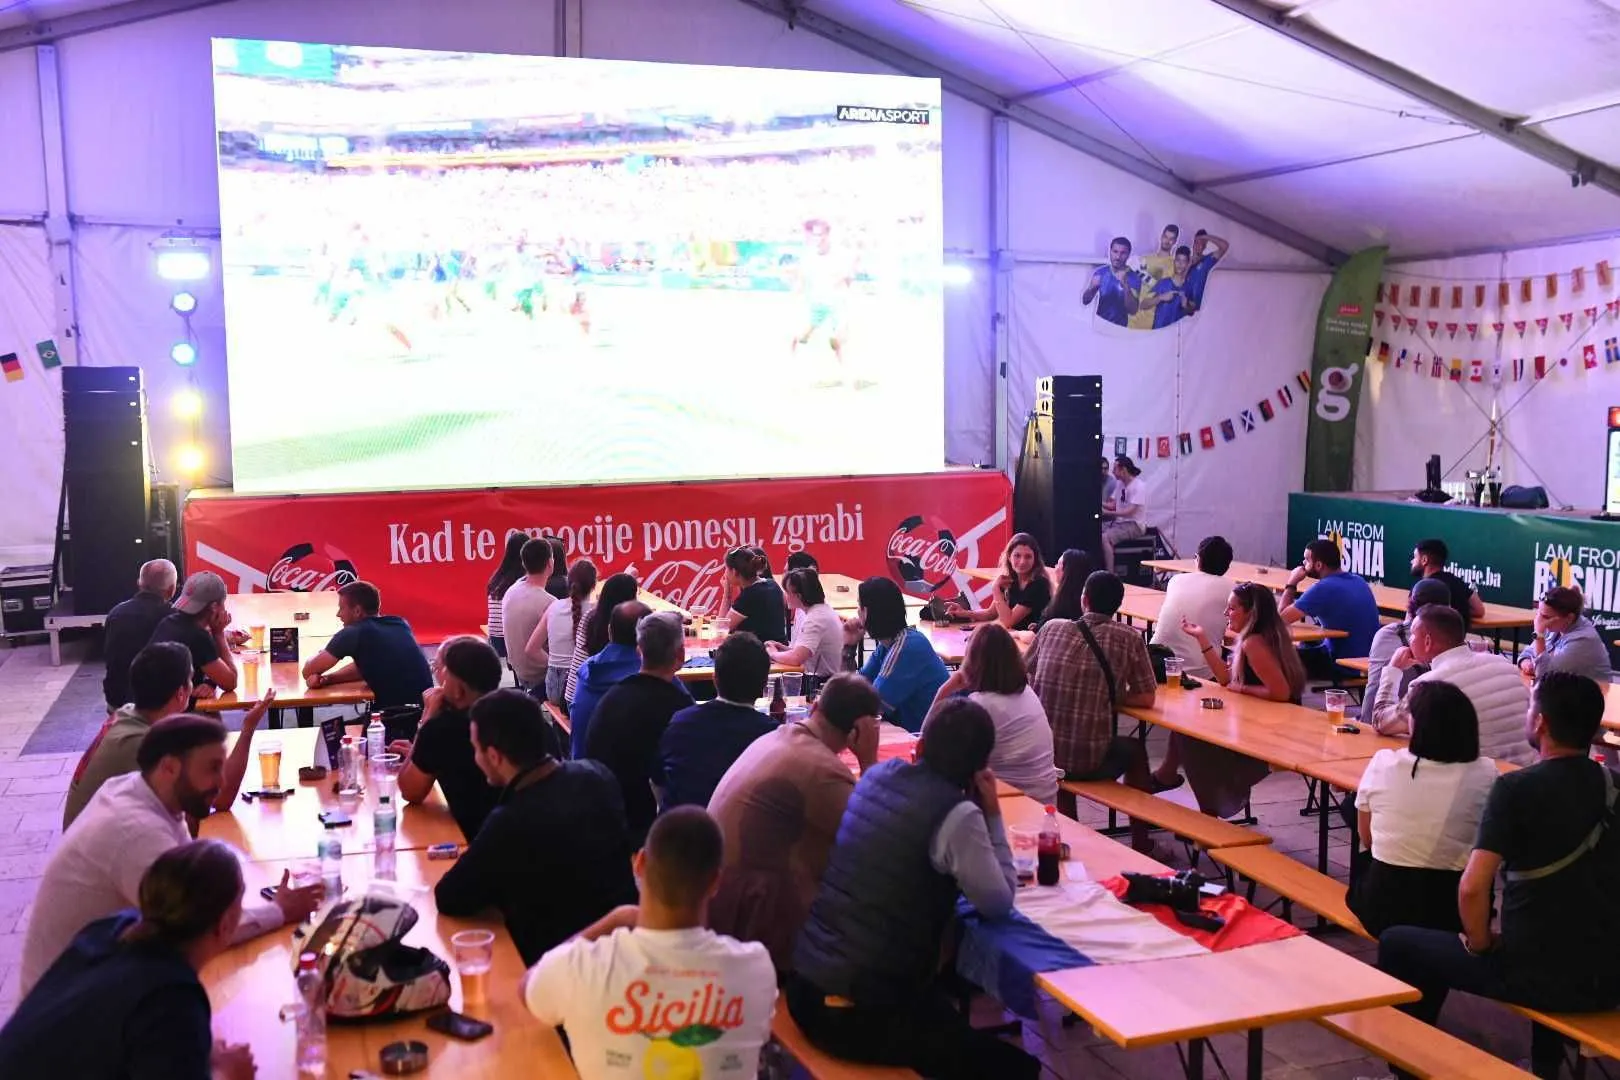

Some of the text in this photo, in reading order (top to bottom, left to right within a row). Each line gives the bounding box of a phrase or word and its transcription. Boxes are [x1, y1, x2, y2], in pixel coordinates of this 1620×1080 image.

[388, 520, 454, 564] Kad
[461, 524, 495, 561] te
[643, 516, 764, 561] ponesu,
[772, 503, 864, 552] zgrabi
[1325, 520, 1344, 537] AM
[1347, 522, 1384, 540] FROM
[1535, 542, 1620, 569] I AM FRO
[606, 980, 744, 1035] Sicilia
